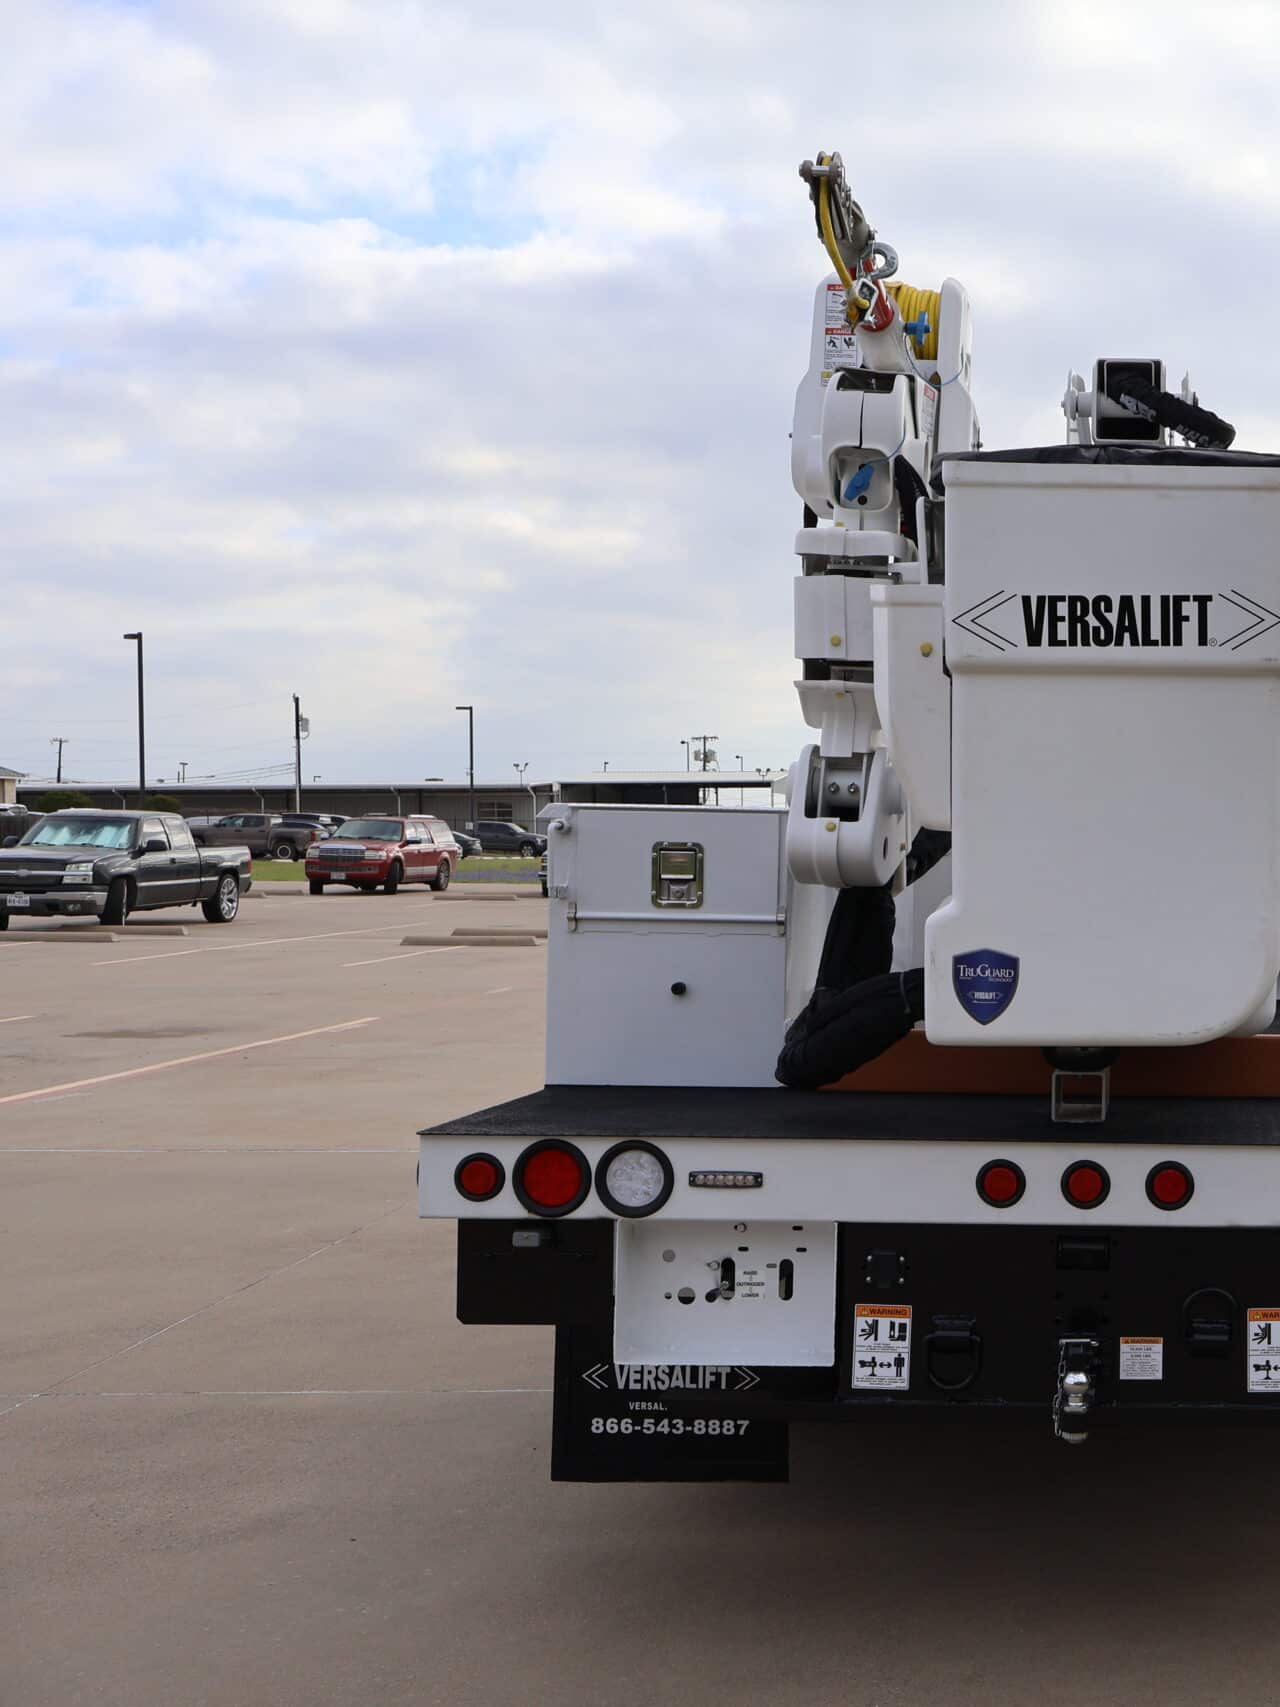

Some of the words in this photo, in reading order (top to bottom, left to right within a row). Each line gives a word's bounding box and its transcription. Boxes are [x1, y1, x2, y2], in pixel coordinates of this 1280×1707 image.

[1021, 595, 1213, 647] VERSALIFT
[870, 1308, 908, 1317] WARNING
[614, 1364, 731, 1391] VERSALIFT
[591, 1417, 750, 1436] 866-543-8887
